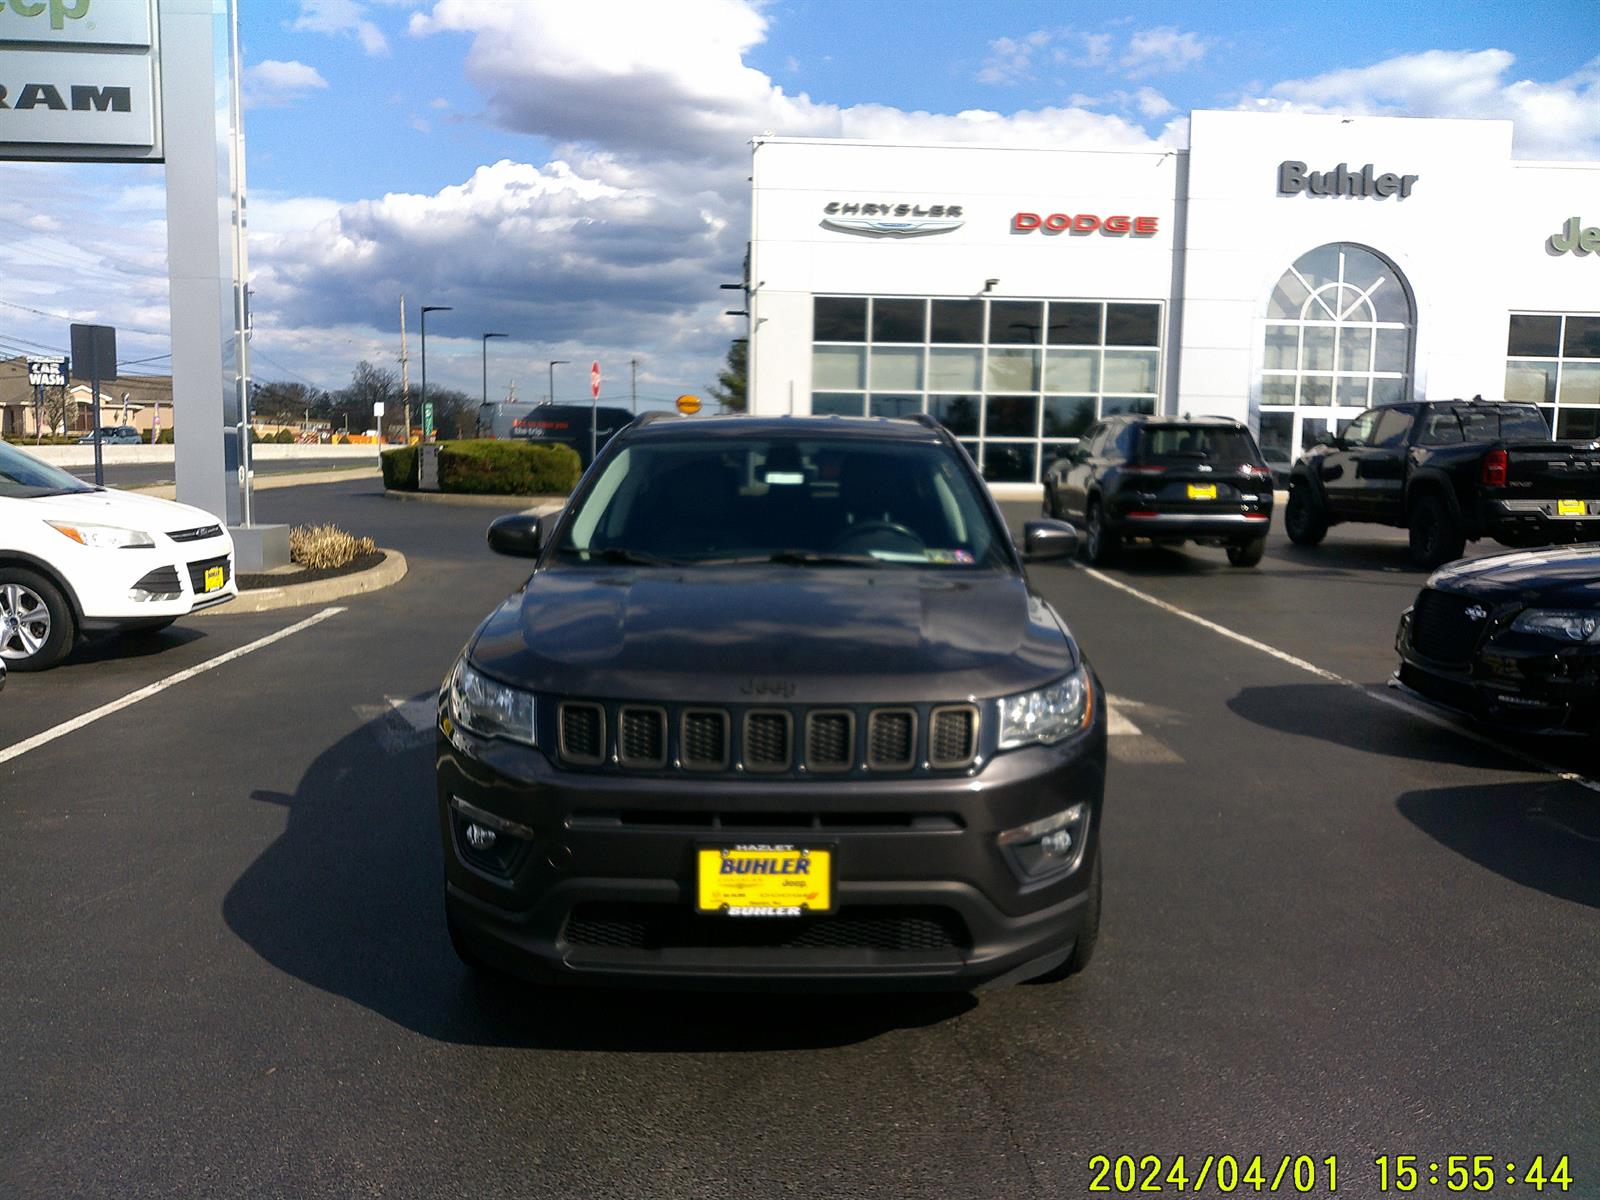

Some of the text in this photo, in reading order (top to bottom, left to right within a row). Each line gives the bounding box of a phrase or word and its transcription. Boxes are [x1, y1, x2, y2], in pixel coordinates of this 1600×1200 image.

[0, 83, 131, 112] AM
[1277, 160, 1419, 201] Buhler
[824, 202, 963, 217] CHRYSLER
[1010, 213, 1159, 237] DODGE
[32, 363, 60, 374] CAR
[29, 373, 65, 385] WASH
[735, 844, 794, 852] HAZLET
[720, 858, 810, 874] BUHLER
[728, 906, 800, 916] BUHLER
